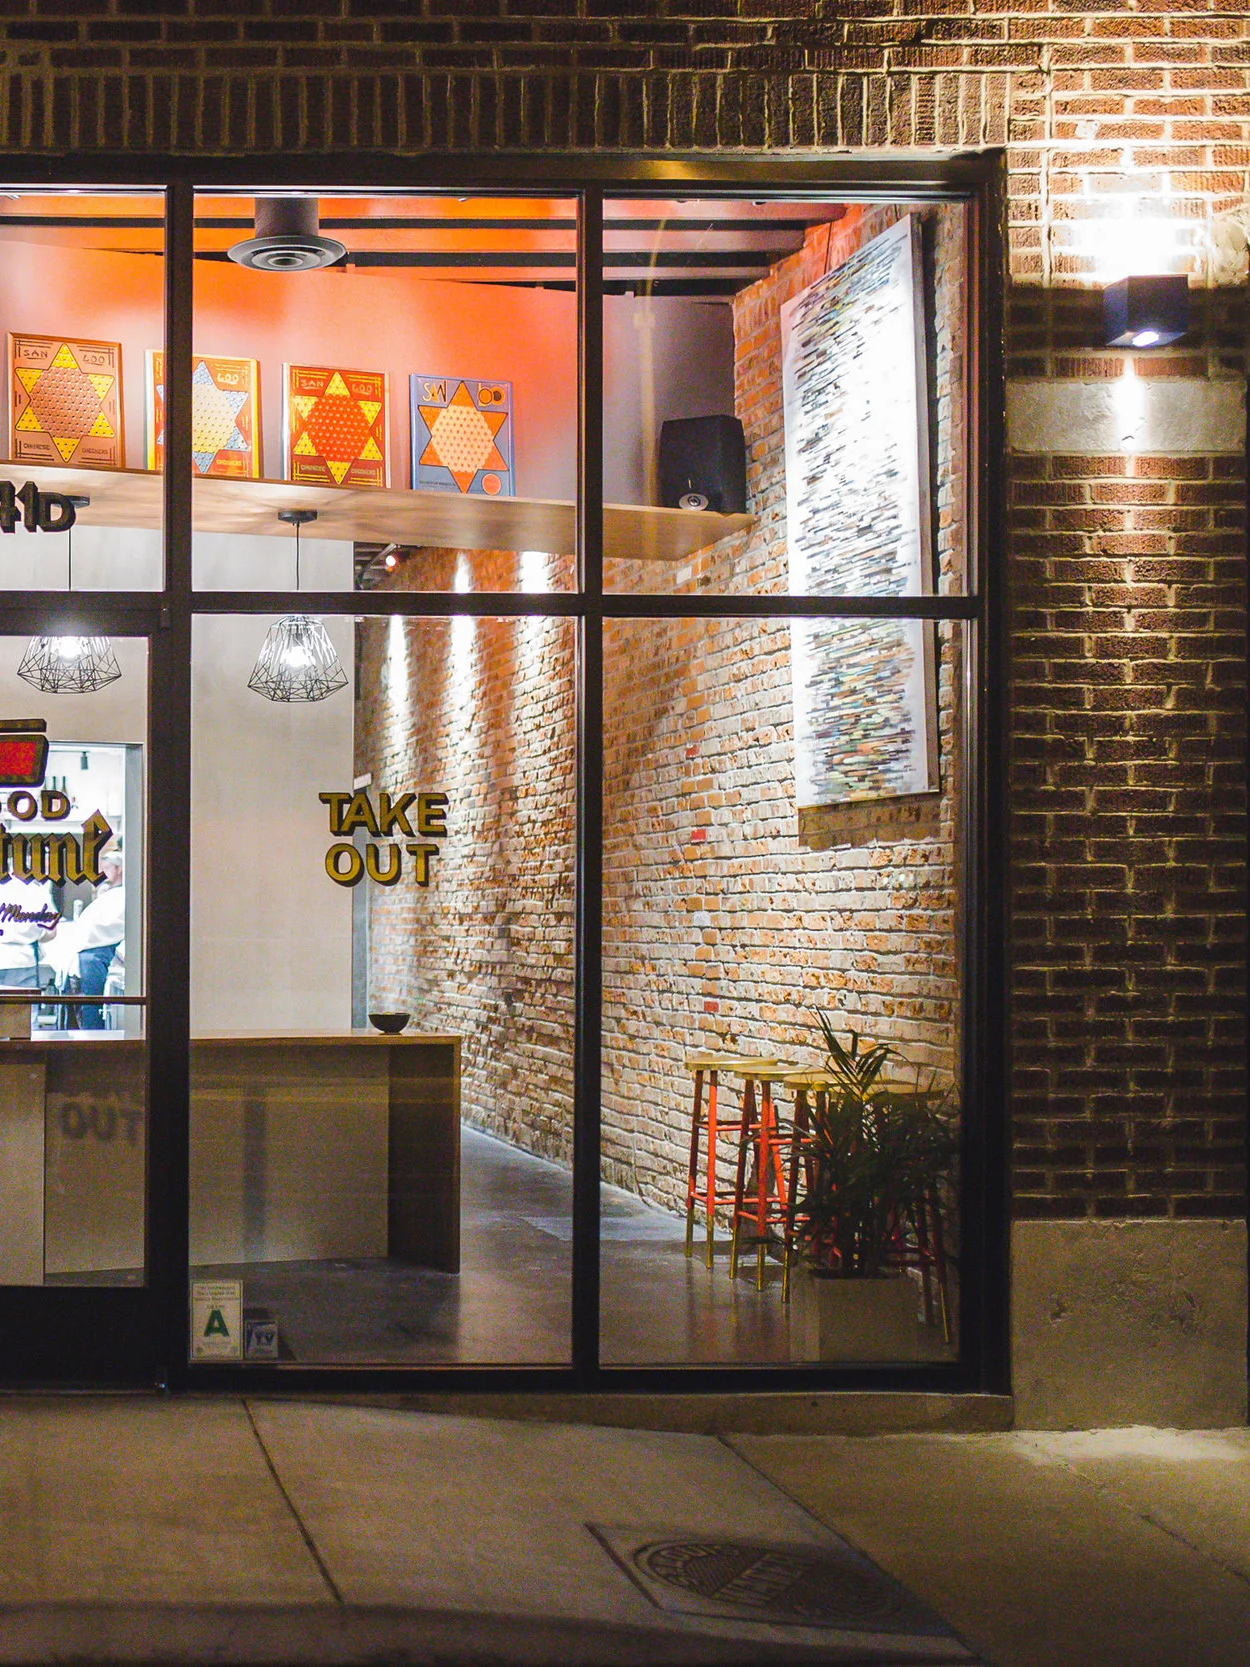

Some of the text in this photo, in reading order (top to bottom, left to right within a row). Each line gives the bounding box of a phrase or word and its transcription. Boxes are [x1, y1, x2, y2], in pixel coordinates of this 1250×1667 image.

[23, 349, 48, 359] SAN
[300, 379, 324, 389] SAN
[318, 792, 449, 837] TAKE
[325, 843, 440, 887] OUT
[204, 1309, 230, 1337] A
